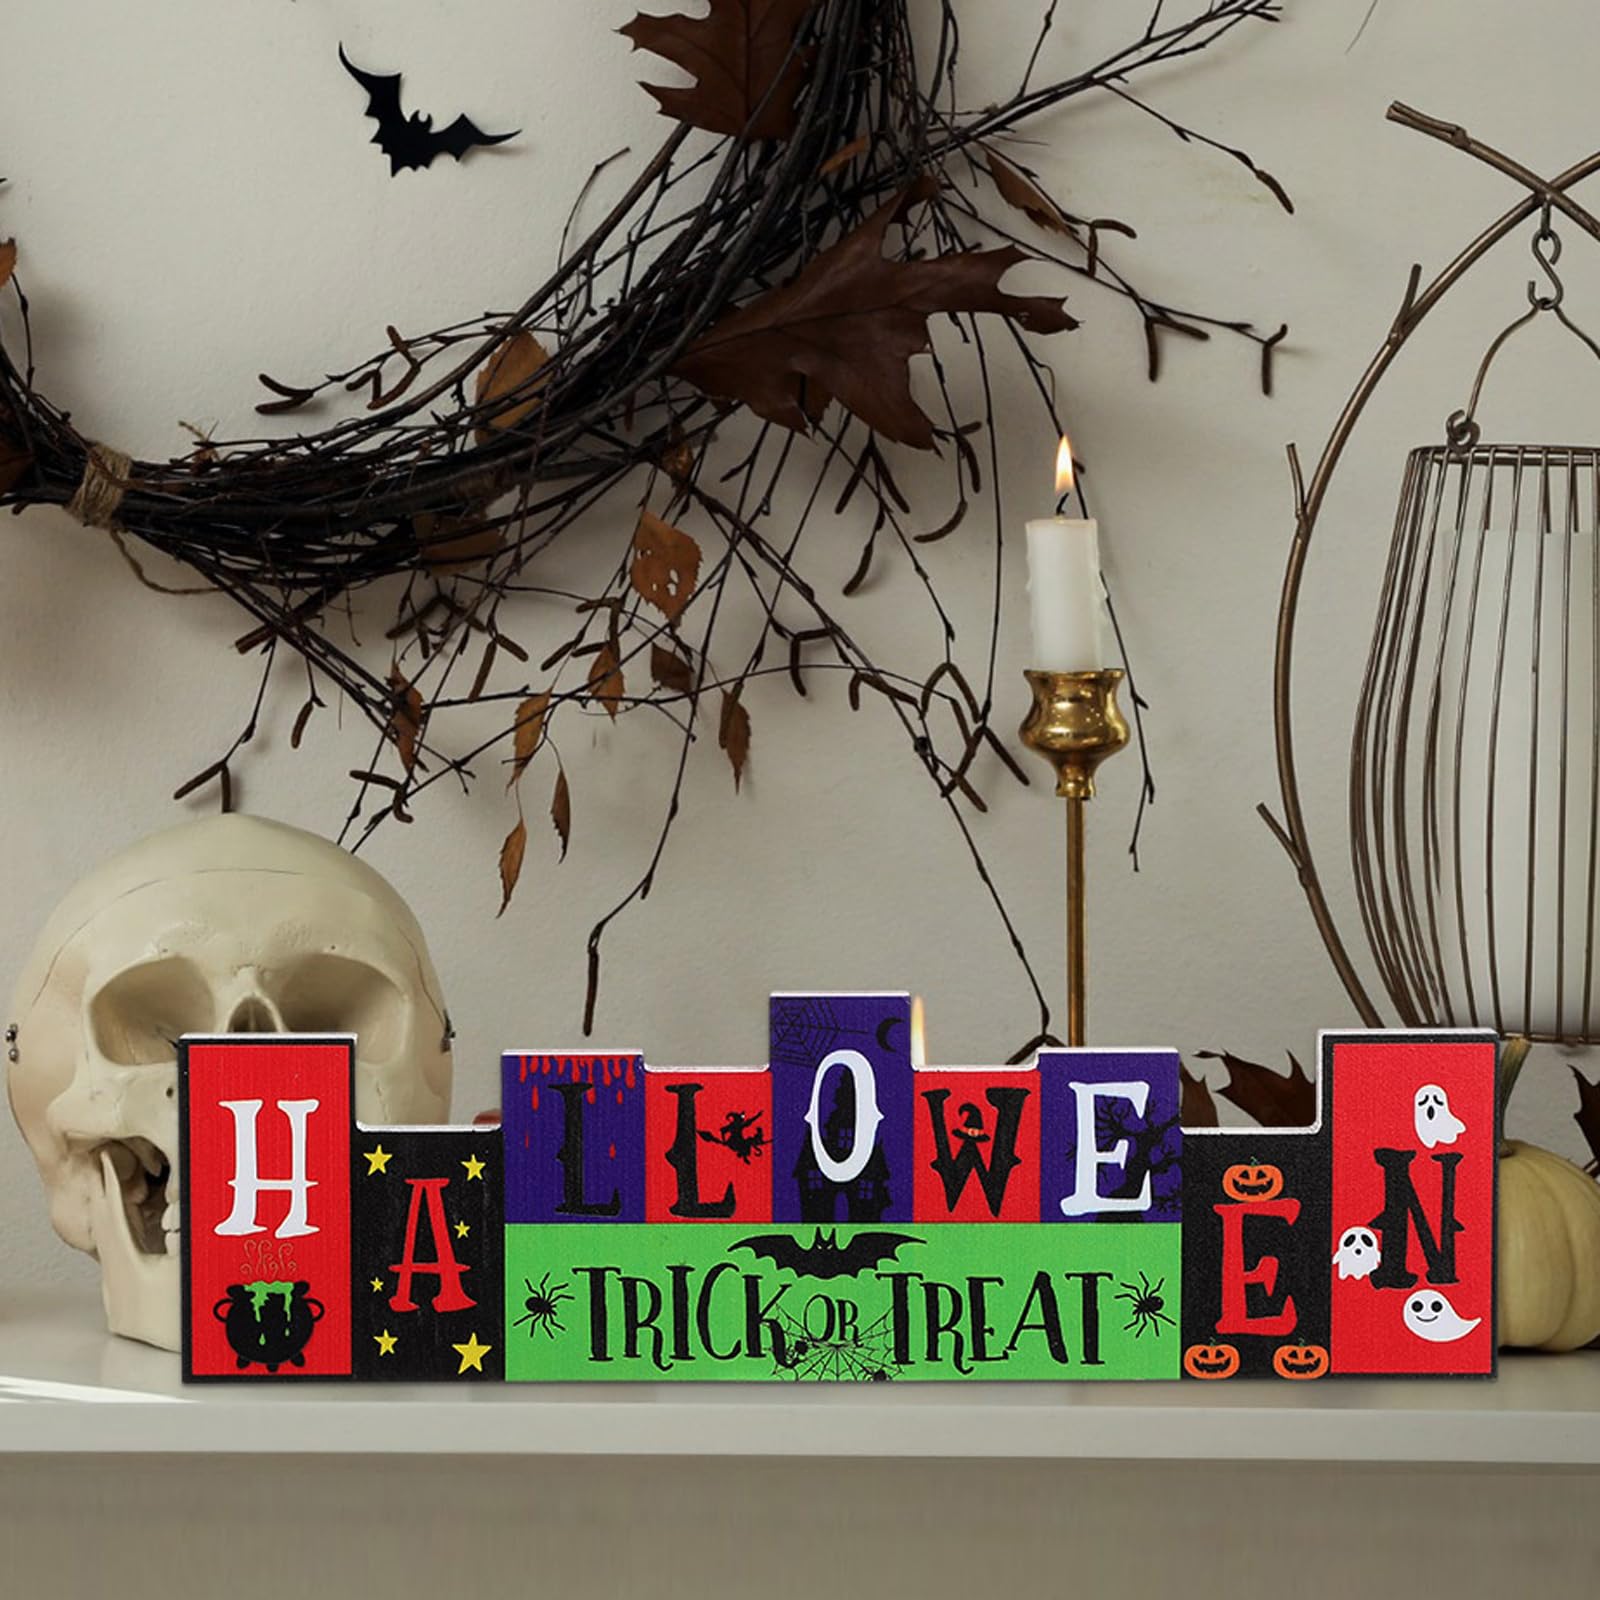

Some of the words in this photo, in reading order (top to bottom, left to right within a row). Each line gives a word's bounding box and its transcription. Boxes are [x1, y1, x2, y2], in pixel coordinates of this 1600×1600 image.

[213, 1050, 1464, 1337] HALLOWEEN
[572, 1262, 799, 1369] TRICK
[803, 1294, 864, 1347] OR
[875, 1271, 1113, 1375] TREAT
